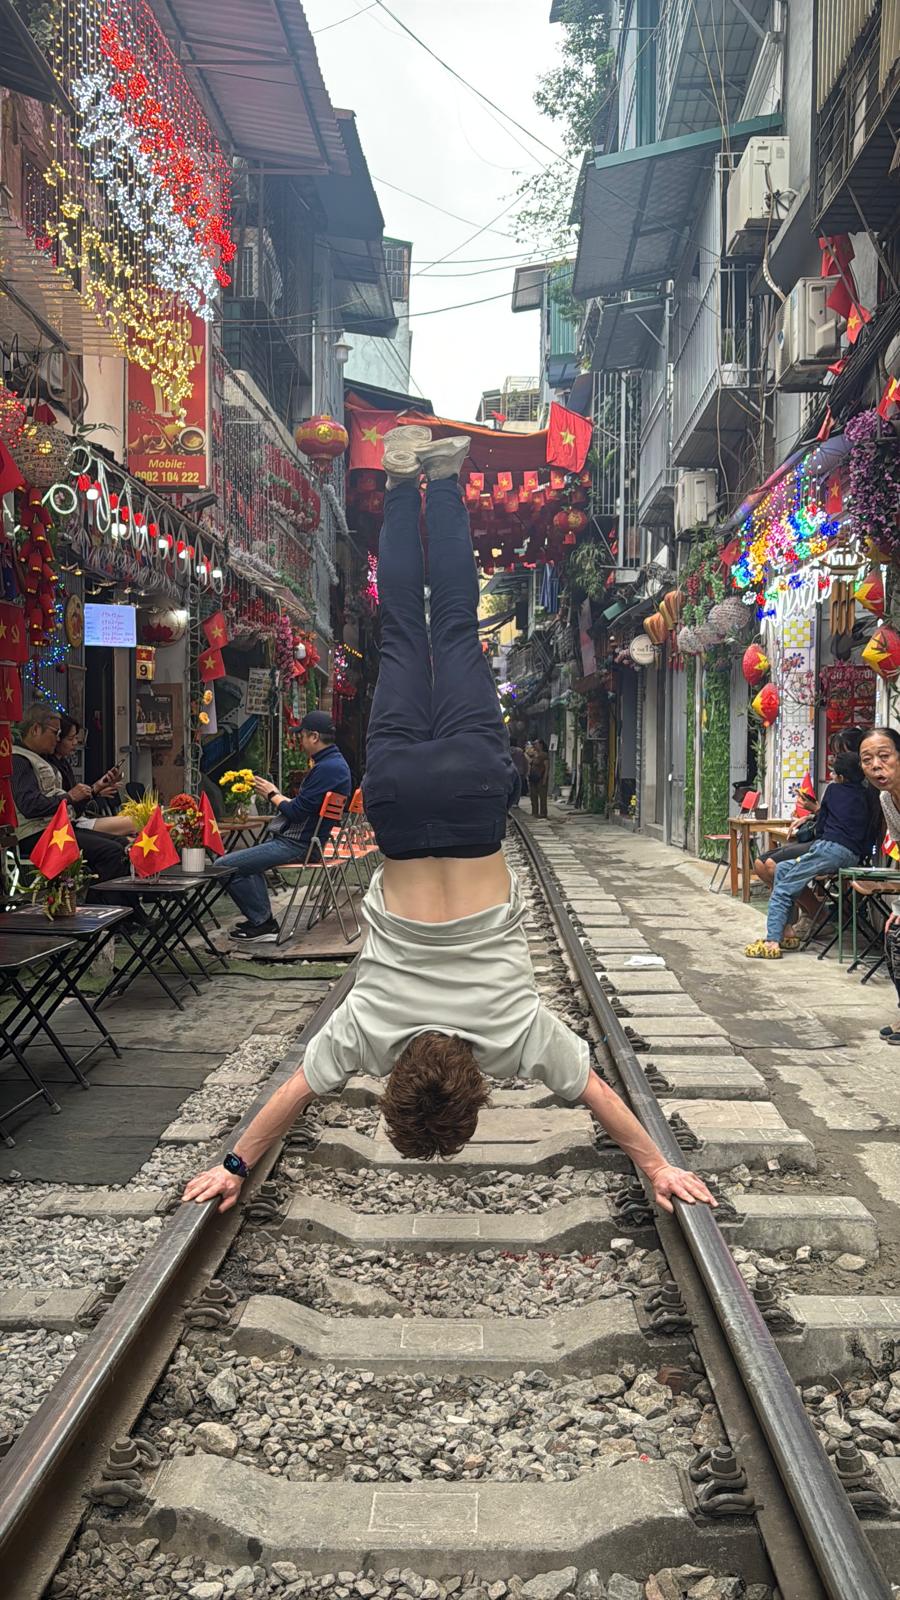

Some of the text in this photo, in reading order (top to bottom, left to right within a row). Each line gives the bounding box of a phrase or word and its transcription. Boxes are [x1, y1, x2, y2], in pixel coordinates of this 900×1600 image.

[148, 459, 186, 469] Mobile:
[161, 471, 179, 482] 104
[181, 472, 200, 483] 222
[139, 664, 148, 676] 9
